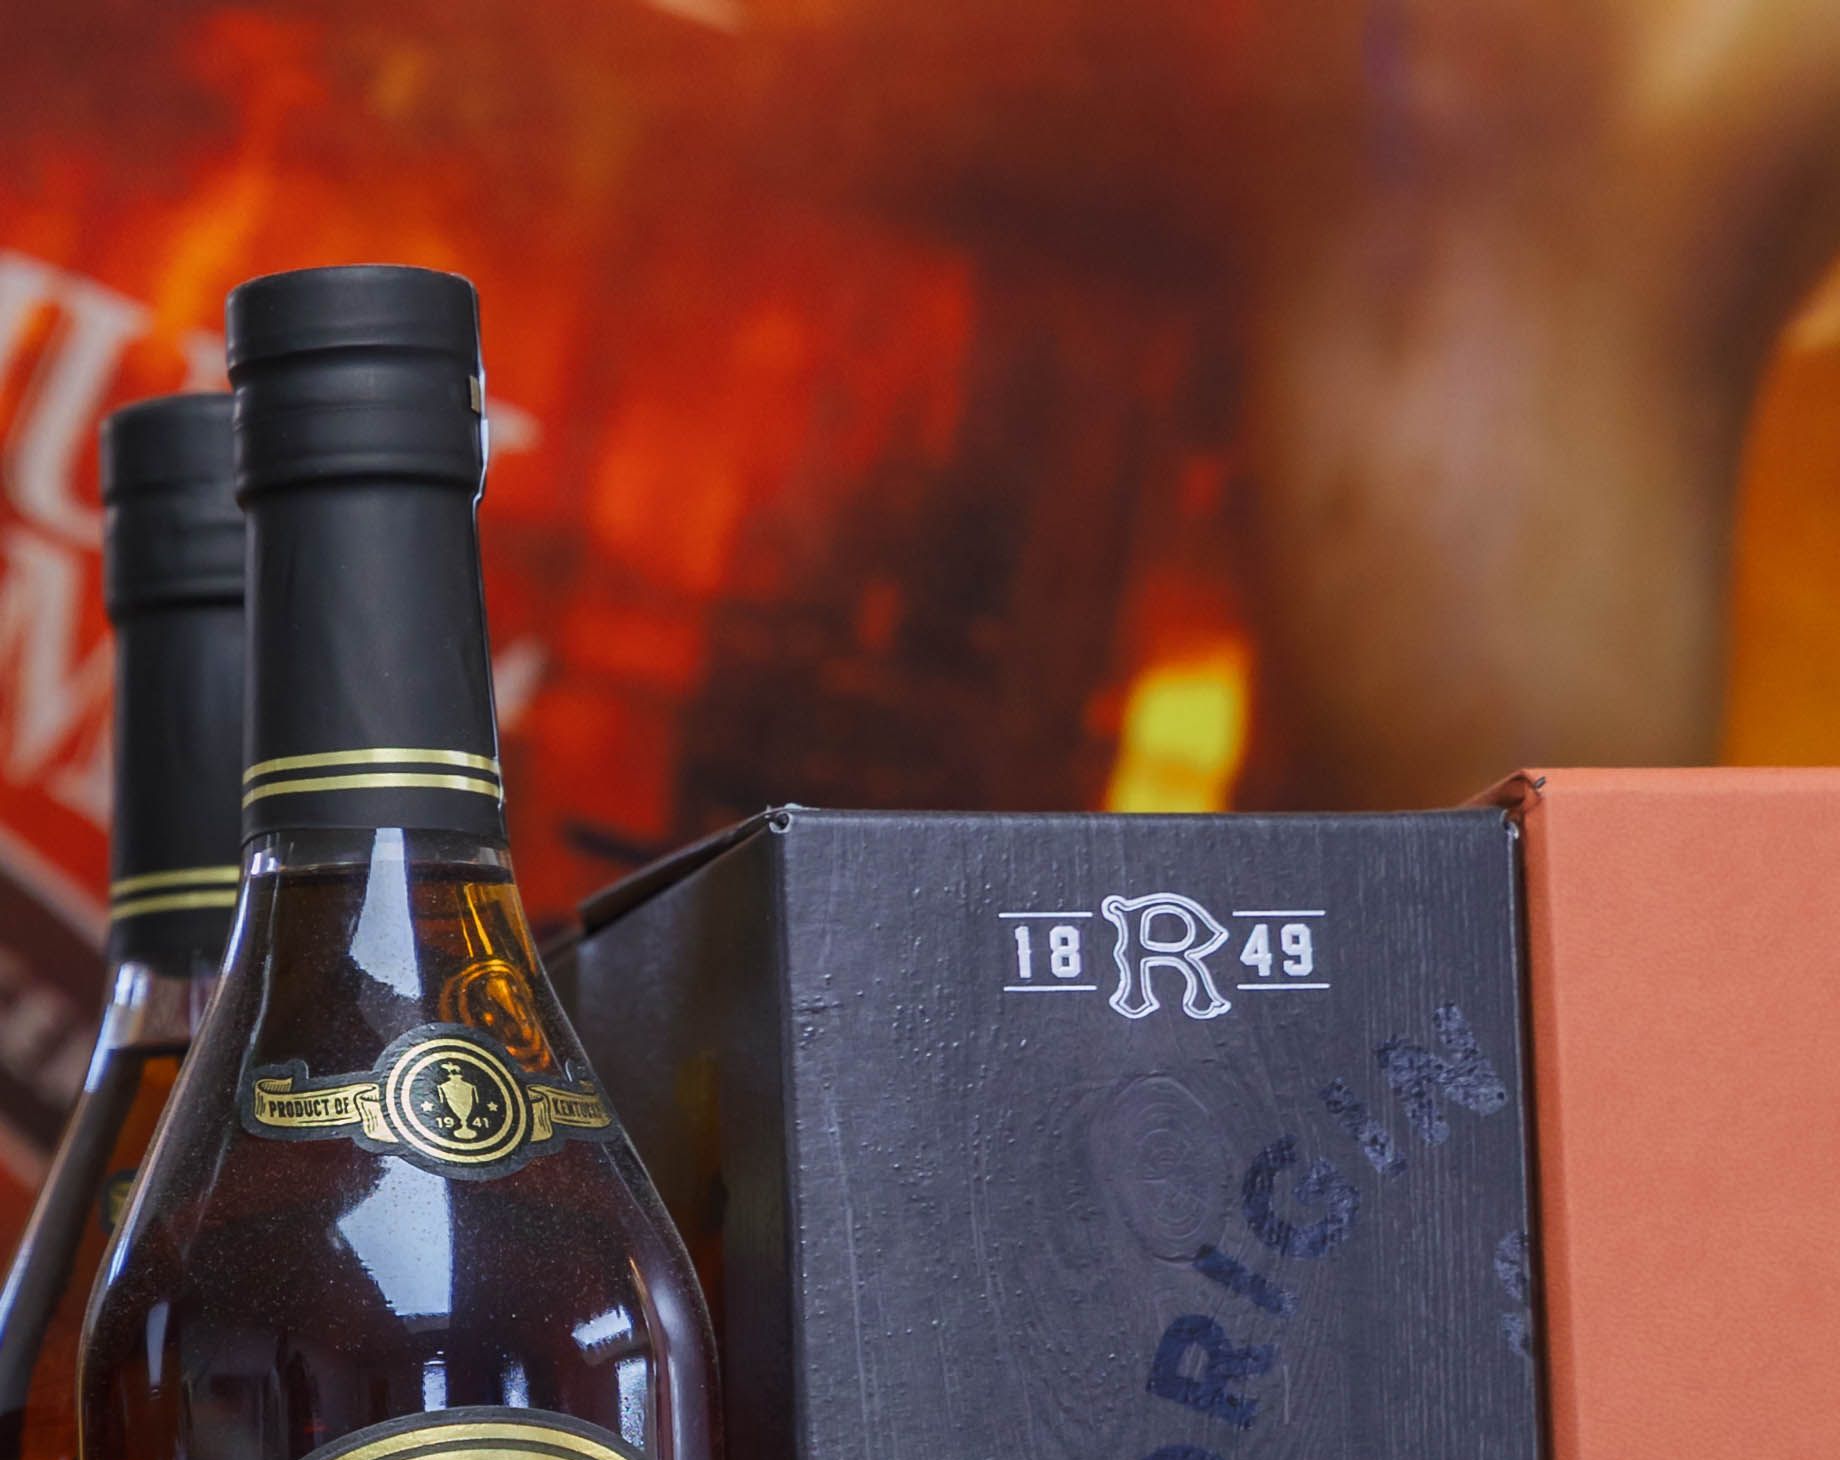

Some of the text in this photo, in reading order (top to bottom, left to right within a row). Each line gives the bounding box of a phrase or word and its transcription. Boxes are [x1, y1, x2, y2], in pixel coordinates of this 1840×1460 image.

[1013, 891, 1315, 1020] 18 R 49
[268, 1095, 351, 1119] PRODUCT OF
[435, 1116, 490, 1130] 19 41
